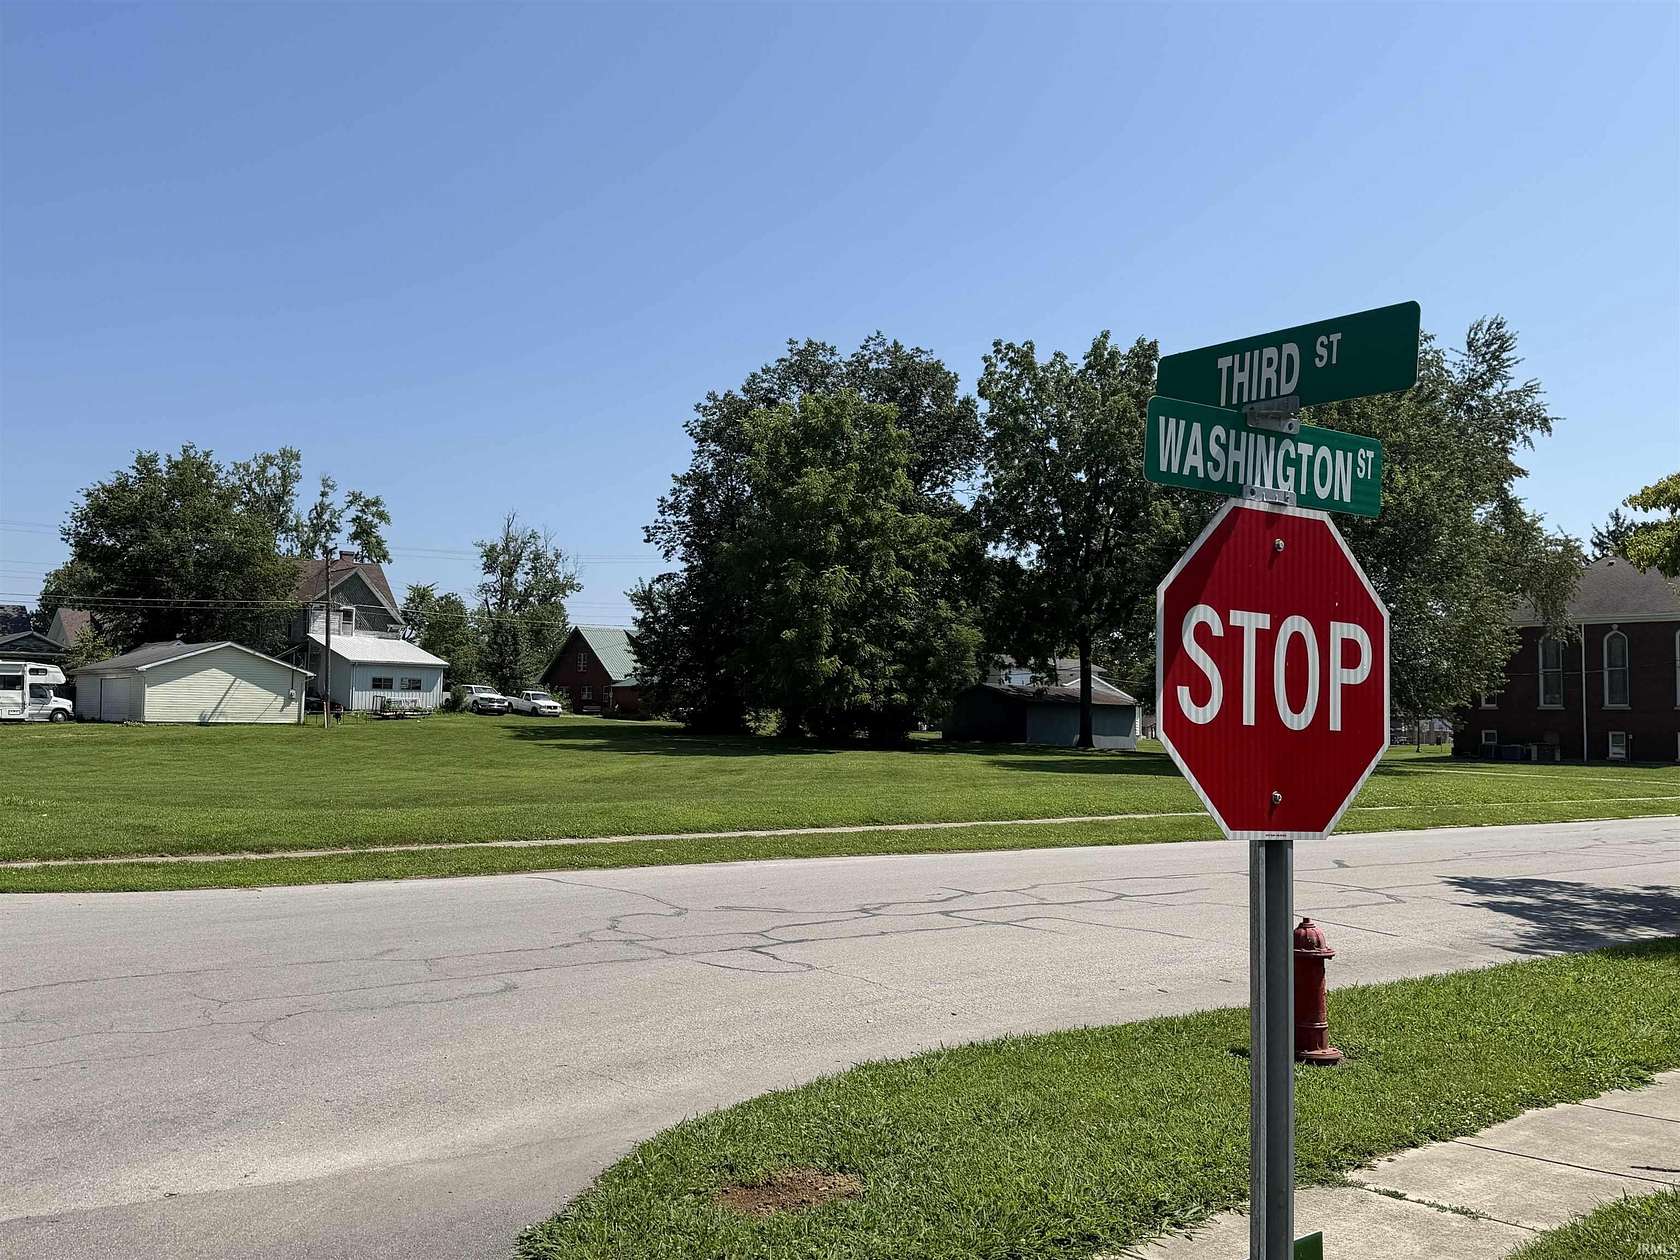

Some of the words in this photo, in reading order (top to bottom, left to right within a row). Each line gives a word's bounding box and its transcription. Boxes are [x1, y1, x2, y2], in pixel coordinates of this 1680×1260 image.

[1217, 342, 1300, 407] THIRD
[1314, 332, 1342, 368] ST
[1158, 415, 1353, 503] WASHINGTON
[1357, 448, 1375, 480] ST
[1176, 604, 1373, 732] STOP
